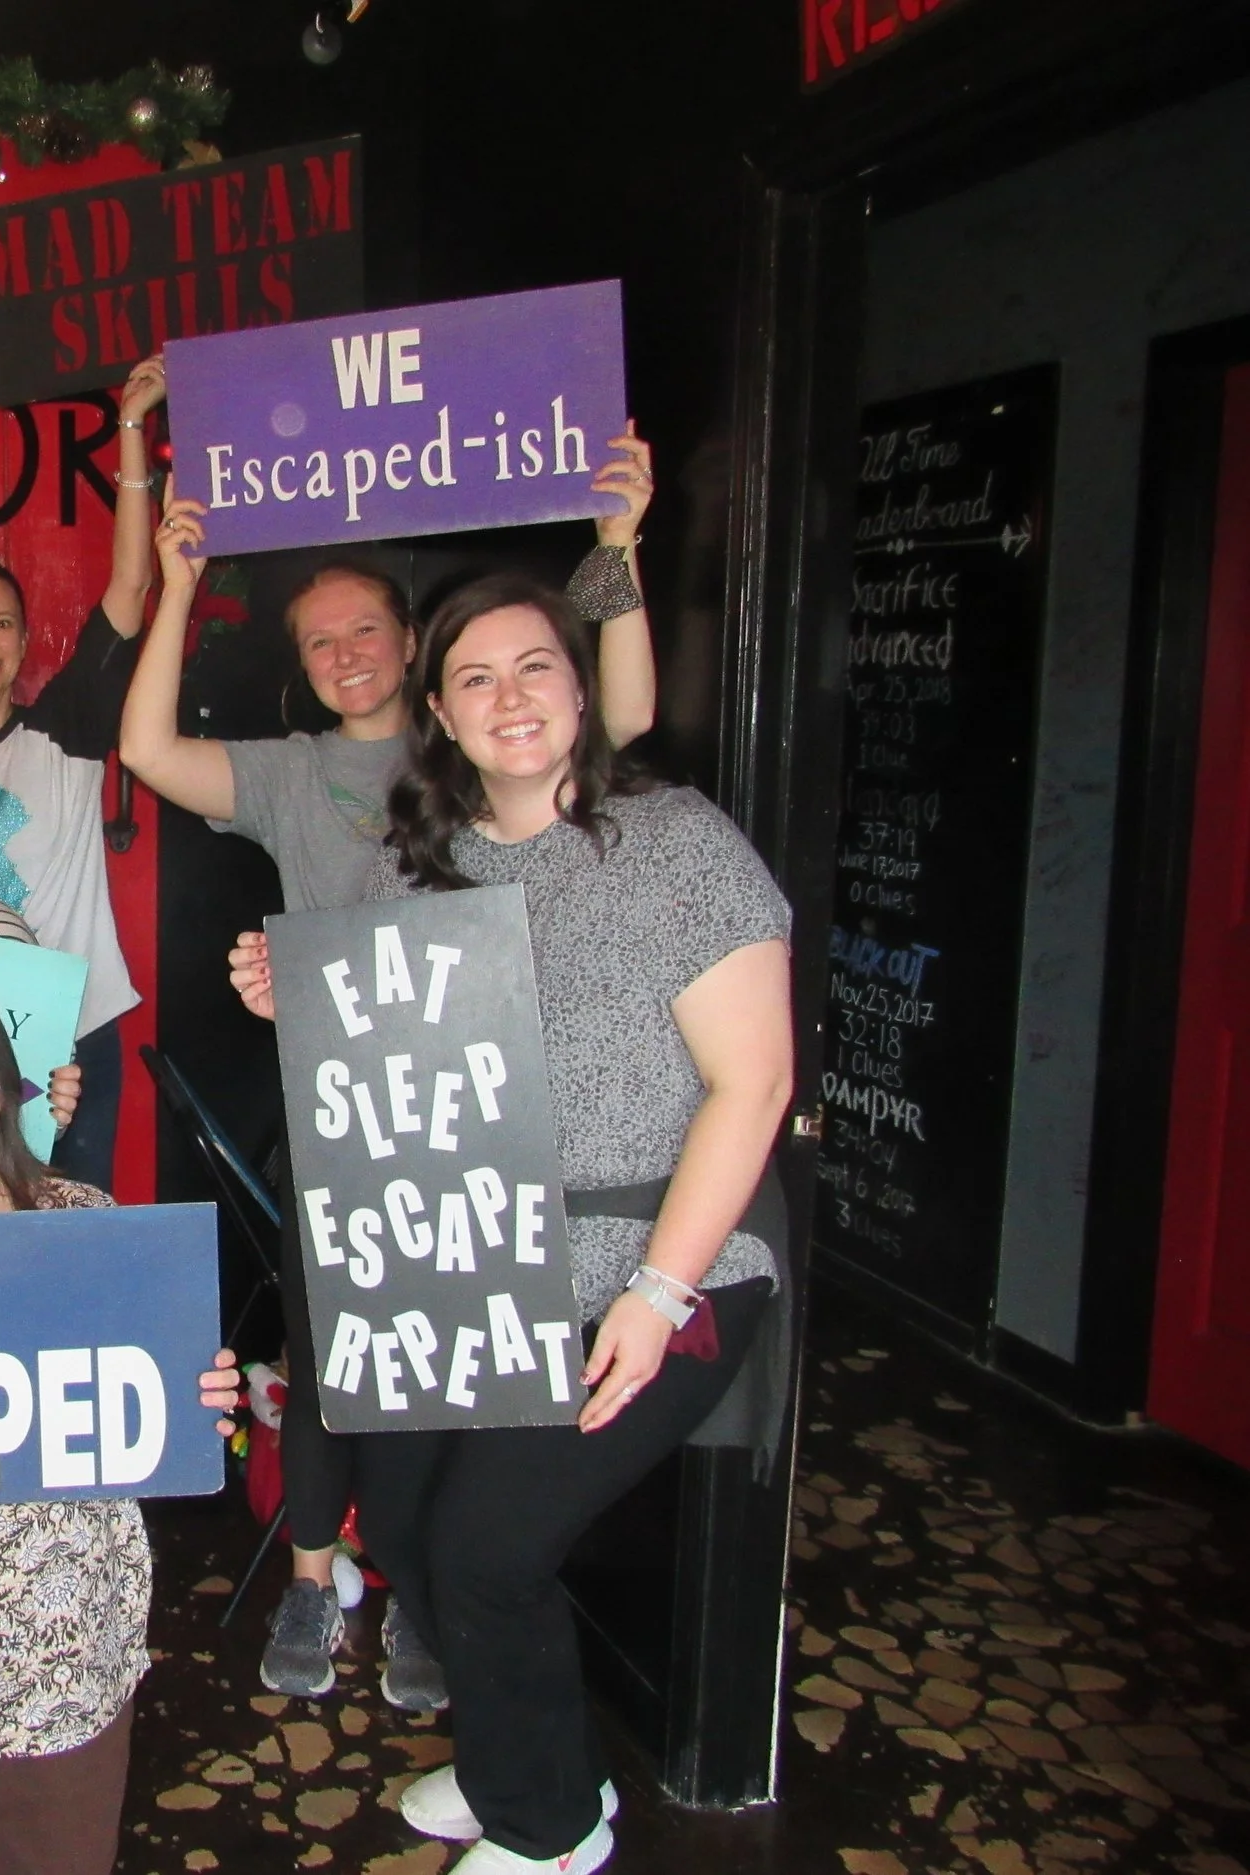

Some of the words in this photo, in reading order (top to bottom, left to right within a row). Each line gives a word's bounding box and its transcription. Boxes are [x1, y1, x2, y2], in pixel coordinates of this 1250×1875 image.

[162, 149, 352, 263] TEAM
[53, 251, 295, 374] SKILLS
[331, 328, 424, 410] WE
[206, 395, 590, 522] Escaped-ish
[857, 821, 917, 857] 37:19
[865, 884, 916, 915] Clues
[322, 925, 462, 1038] EAT
[838, 1008, 902, 1059] 32:18
[316, 1041, 507, 1159] SLEEP
[852, 1050, 903, 1089] Clues
[304, 1167, 545, 1288] ESCAPE
[323, 1293, 570, 1411] REPEAT
